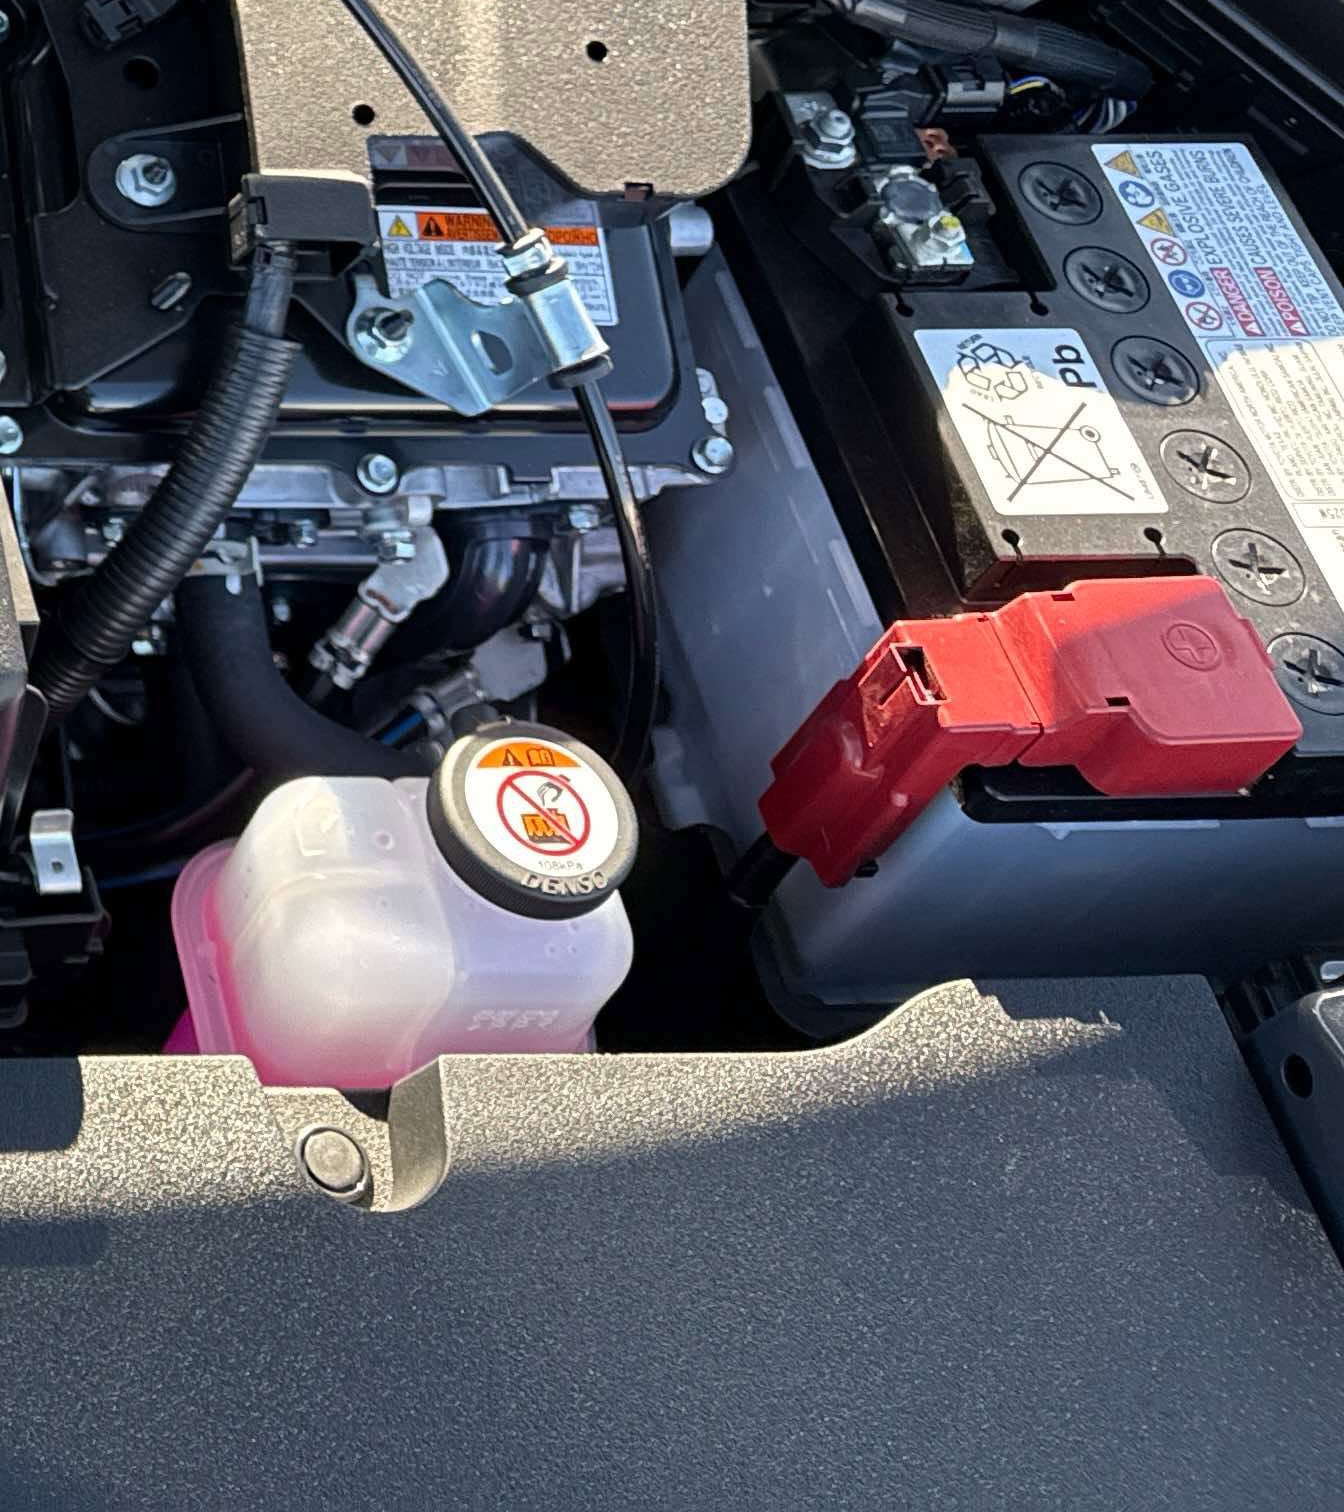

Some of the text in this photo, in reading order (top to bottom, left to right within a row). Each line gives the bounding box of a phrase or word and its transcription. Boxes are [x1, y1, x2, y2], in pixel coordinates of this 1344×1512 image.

[1221, 148, 1252, 183] CHILDREN
[445, 214, 493, 228] WARNIN
[1143, 151, 1255, 320] DANGER EXPLOSIVE GASES
[1187, 150, 1300, 320] POISON CAUSES SEVERE BURNS
[1052, 345, 1098, 388] Pb
[520, 870, 609, 896] DENSO
